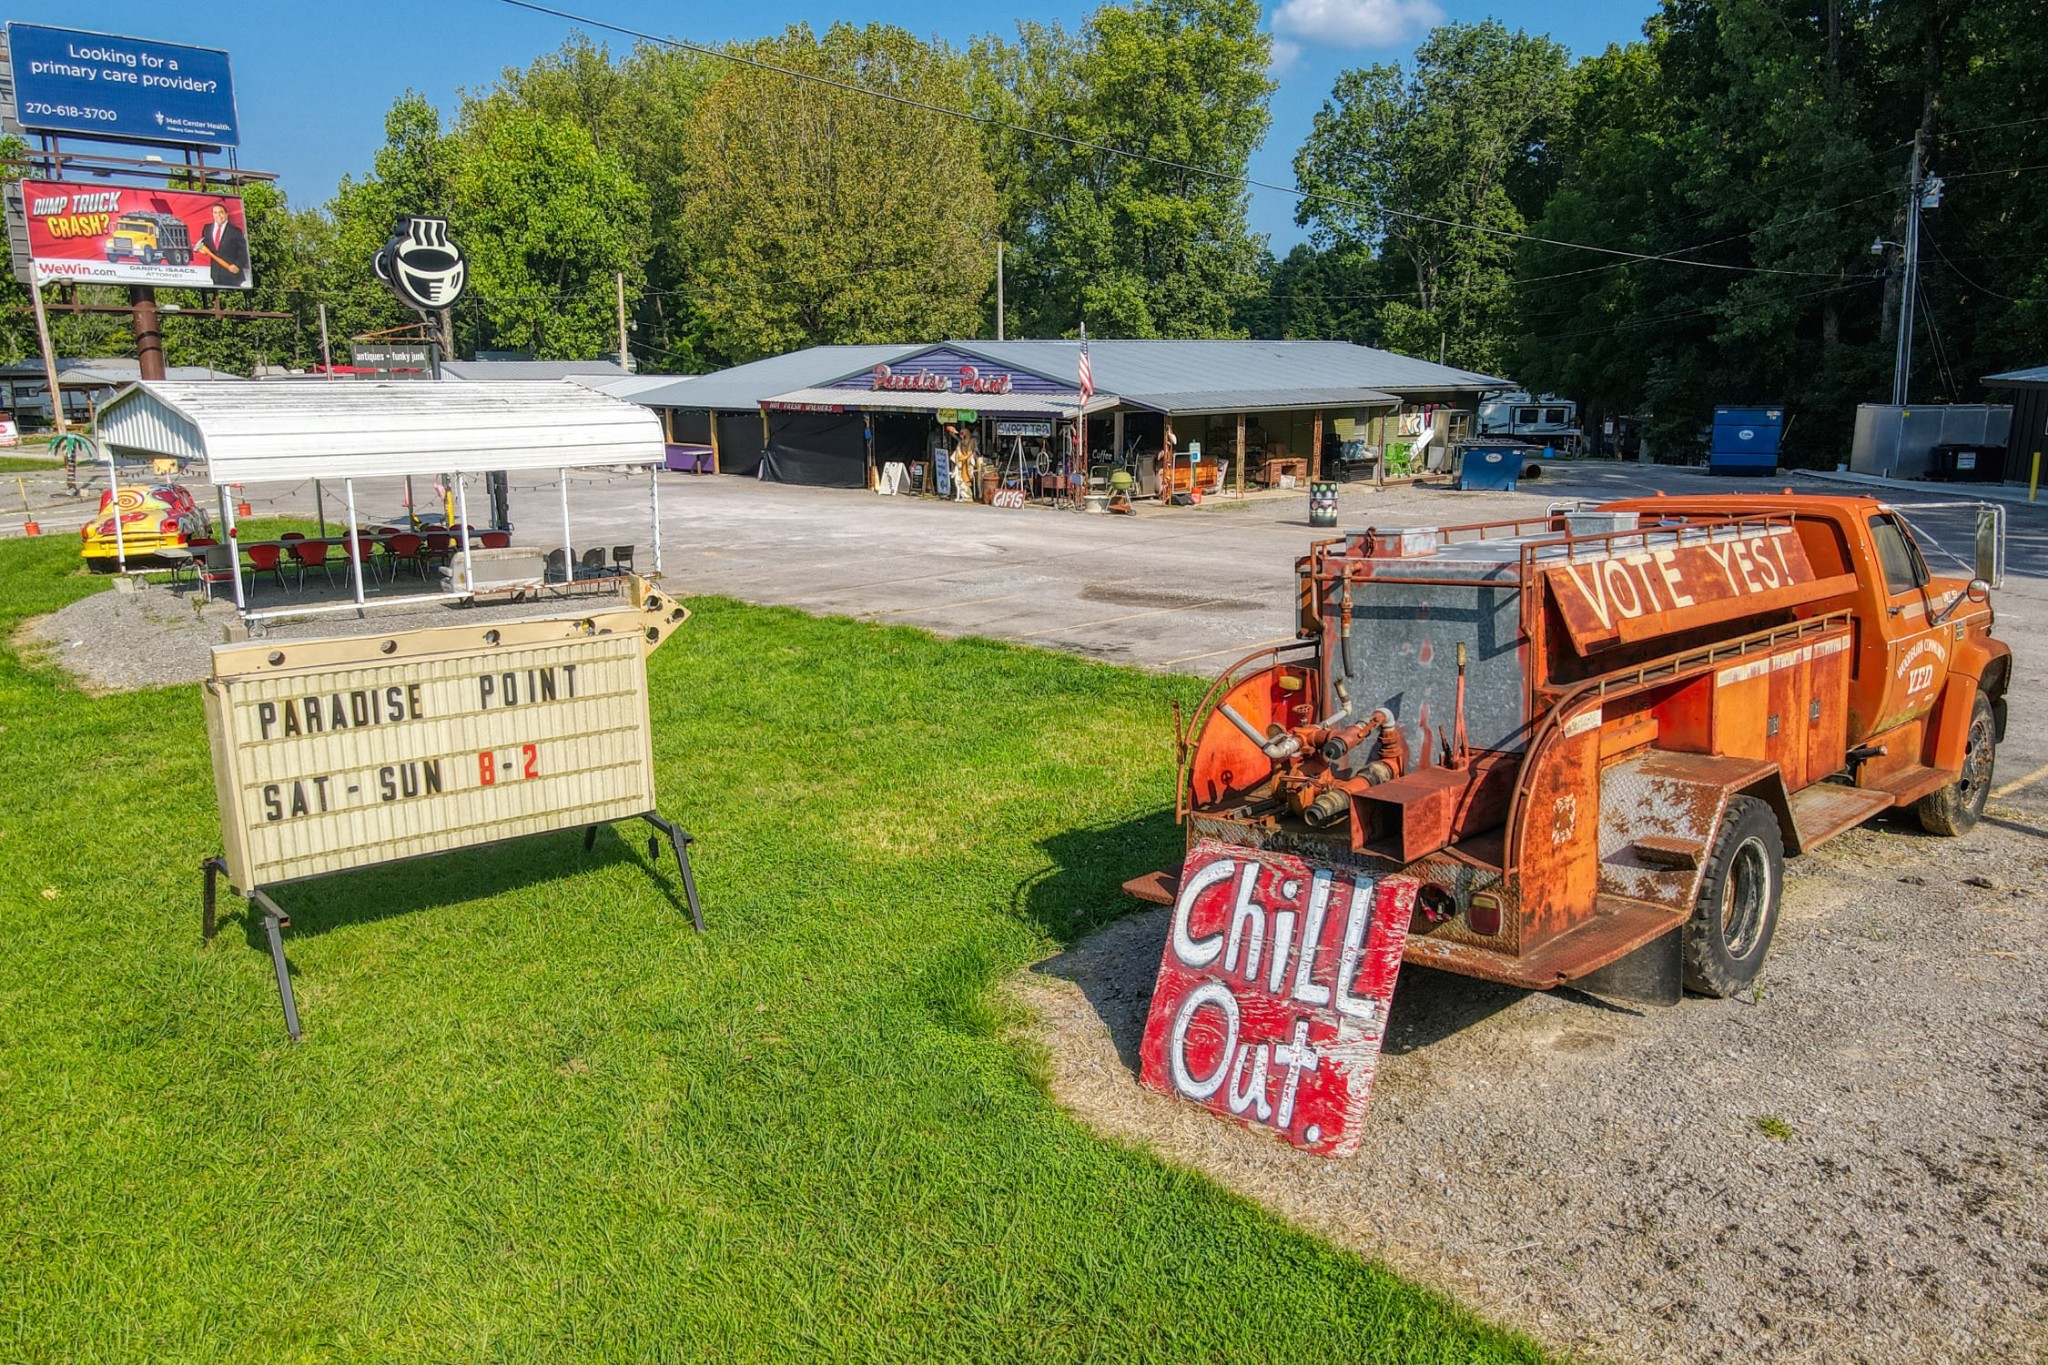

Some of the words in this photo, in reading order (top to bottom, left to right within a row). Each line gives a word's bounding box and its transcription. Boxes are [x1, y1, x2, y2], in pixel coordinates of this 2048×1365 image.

[69, 44, 137, 68] Looking
[141, 53, 164, 70] for
[169, 59, 179, 71] a
[31, 61, 97, 81] primary
[102, 69, 138, 84] care
[143, 73, 218, 94] provider?
[26, 103, 118, 121] 270-618-3700
[165, 117, 181, 125] Med
[182, 119, 206, 128] Center
[33, 196, 68, 216] DUMP
[72, 191, 122, 214] TRUCK
[46, 213, 111, 239] CRASH?
[39, 263, 117, 277] WeWin.com
[356, 352, 385, 363] antiques
[392, 352, 410, 363] funky
[411, 352, 425, 363] junk
[873, 364, 952, 392] Paradise
[959, 365, 1013, 393] Point
[1092, 449, 1113, 463] Coffee
[993, 491, 1024, 508] GIFTS
[1566, 550, 1695, 629] VOTE
[1705, 537, 1795, 597] YES!
[1907, 664, 1933, 695] VFD
[258, 683, 424, 740] PARADISE
[479, 665, 577, 710] POINT
